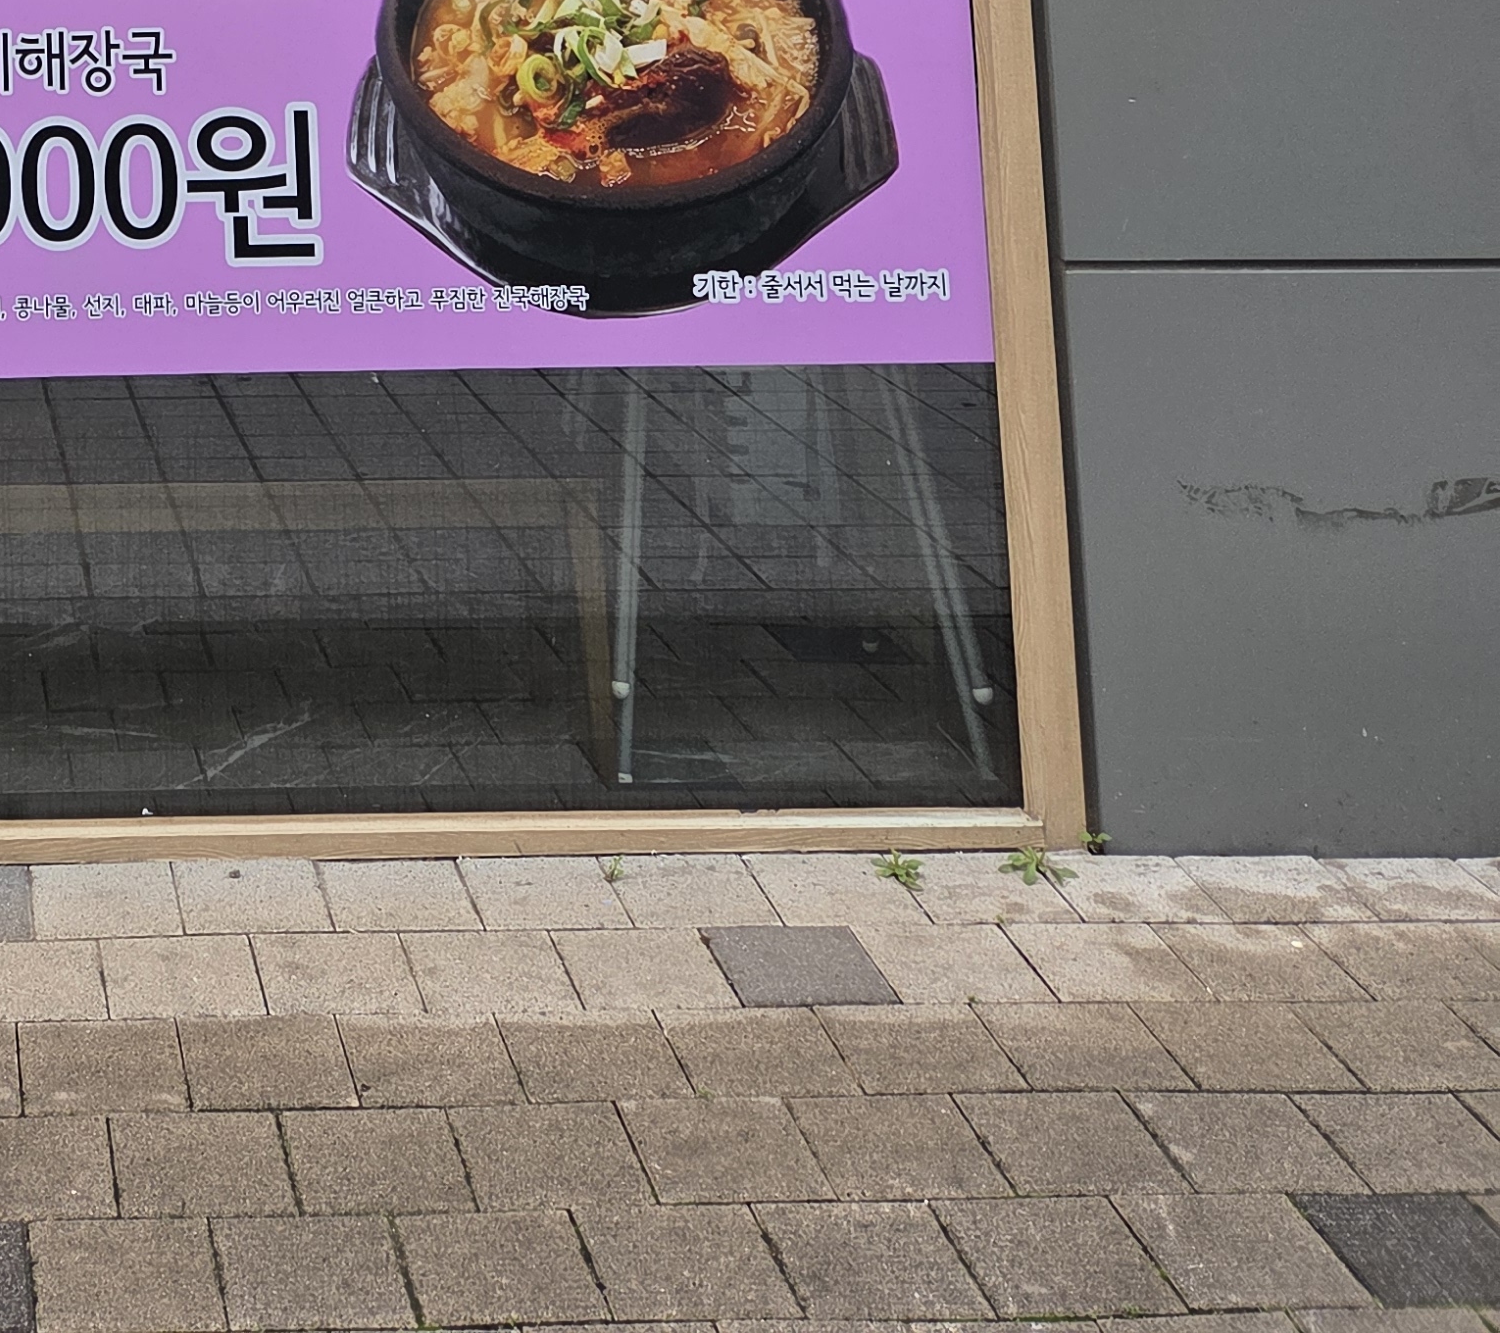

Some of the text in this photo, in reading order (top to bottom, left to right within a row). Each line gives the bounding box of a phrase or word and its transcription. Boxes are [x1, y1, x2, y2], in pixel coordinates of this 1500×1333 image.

[695, 274, 740, 300] 기한
[761, 273, 825, 300] 줄서서
[832, 273, 875, 299] 먹는
[882, 271, 948, 299] 날까지
[14, 296, 77, 320] 콩나물,
[83, 294, 126, 318] 선지,
[134, 293, 177, 317] 대파,
[185, 292, 260, 315] 마늘등이
[267, 289, 340, 313] 어우러진
[347, 289, 423, 311] 얼큰하고
[429, 287, 486, 311] 푸짐한
[493, 285, 590, 311] 진국해장국
